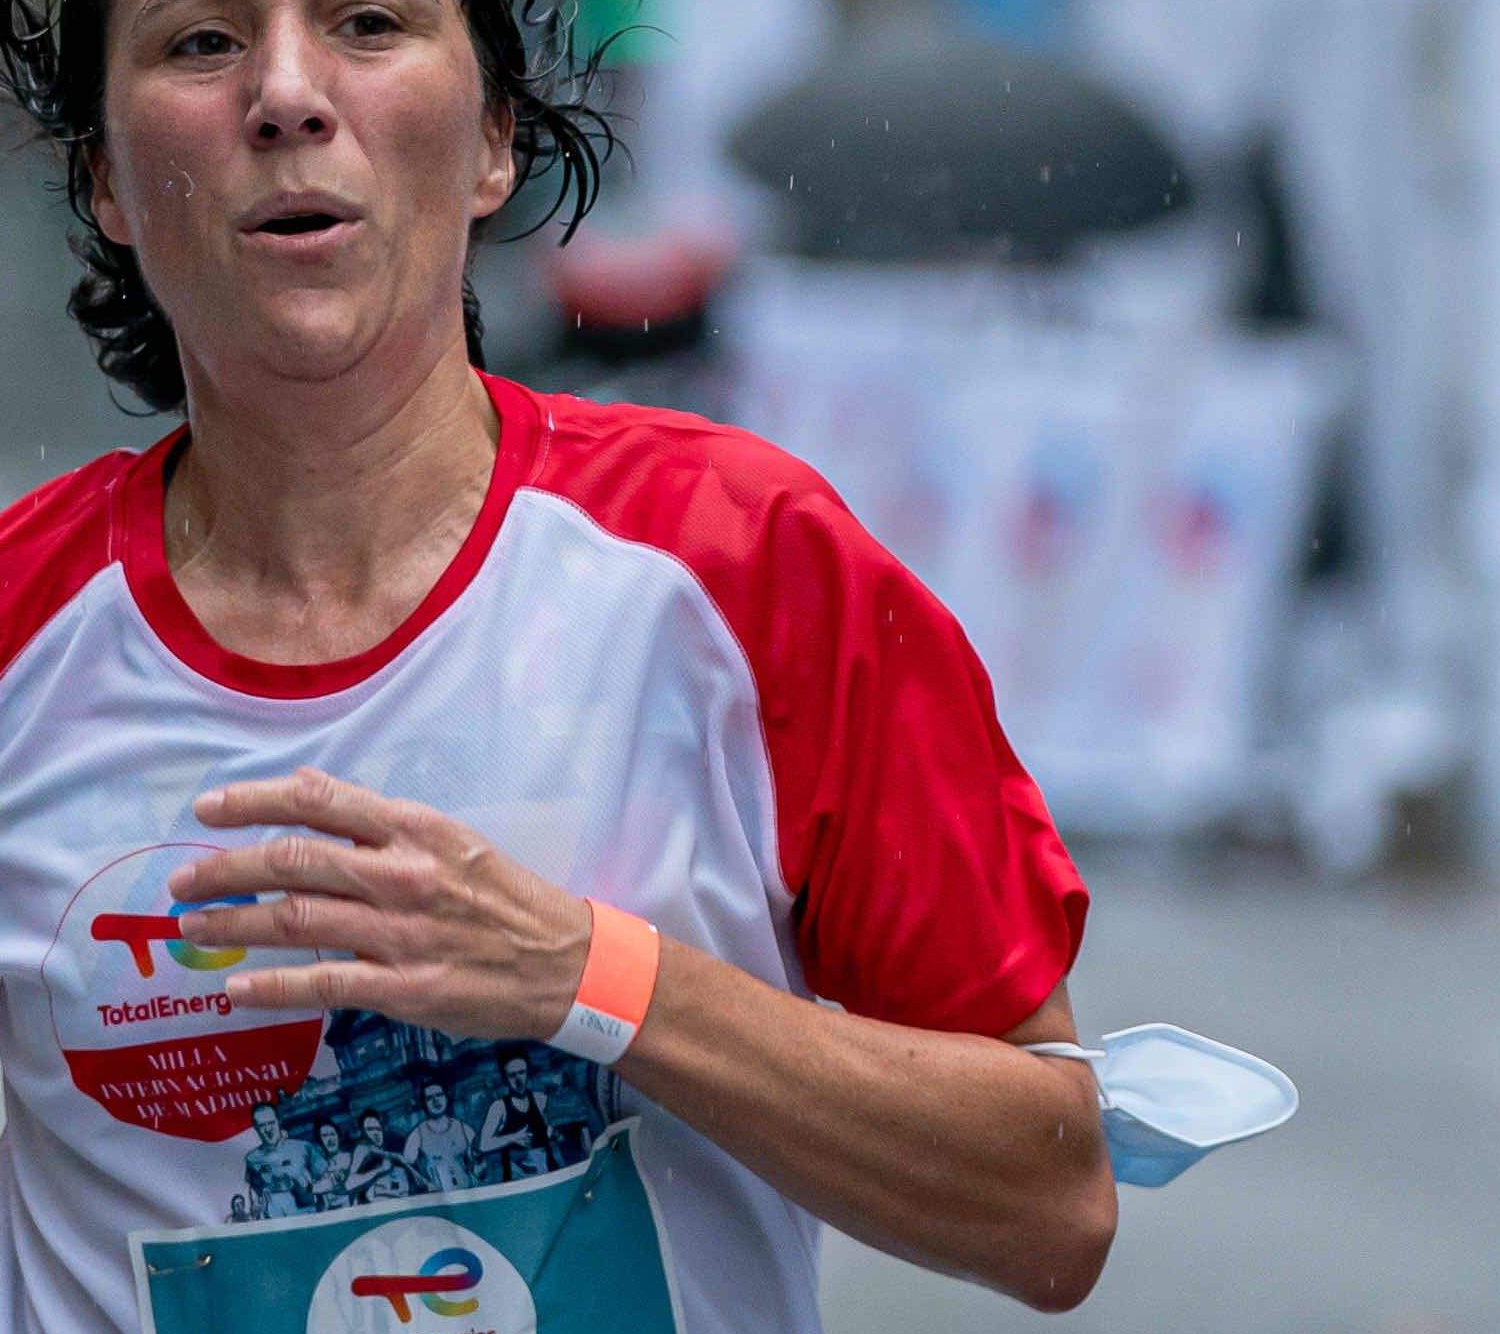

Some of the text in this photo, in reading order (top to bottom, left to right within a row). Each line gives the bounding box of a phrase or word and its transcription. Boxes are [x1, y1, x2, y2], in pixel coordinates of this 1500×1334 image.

[97, 992, 233, 1027] TotalEnerg
[148, 1045, 227, 1070] MILLA
[137, 1088, 272, 1119] DE MADRID
